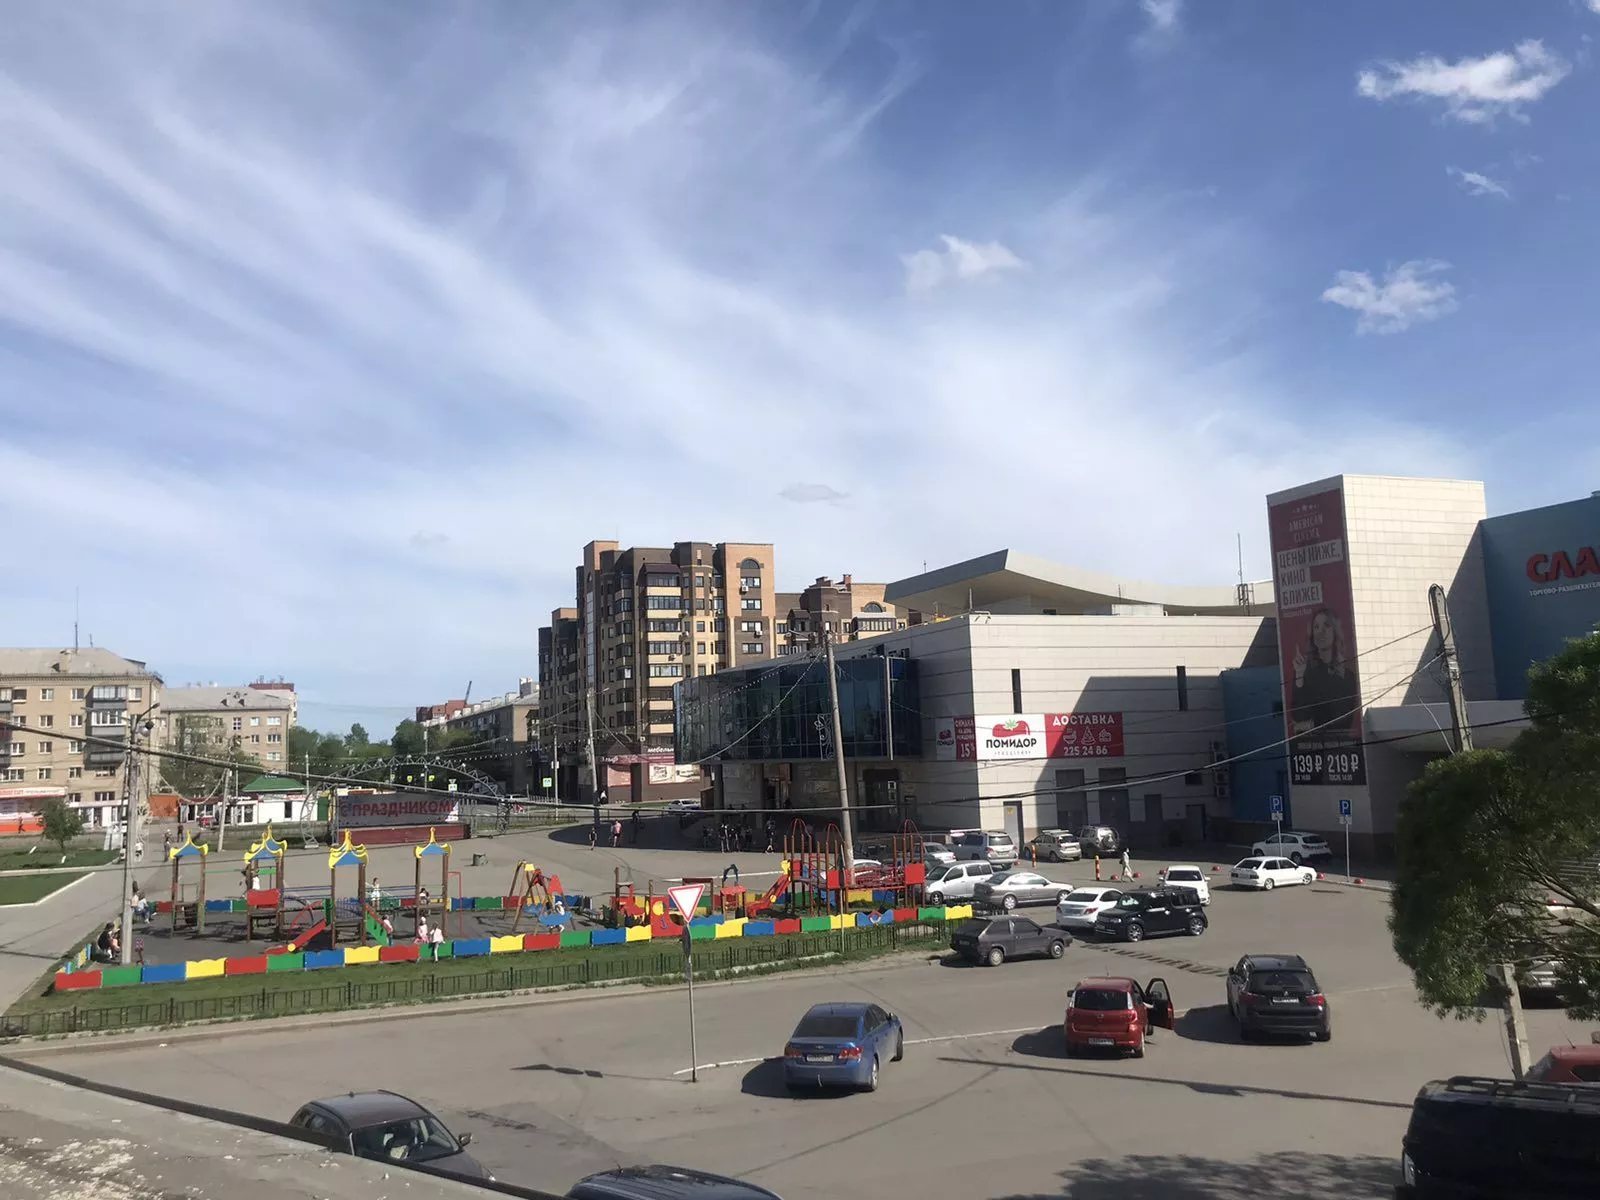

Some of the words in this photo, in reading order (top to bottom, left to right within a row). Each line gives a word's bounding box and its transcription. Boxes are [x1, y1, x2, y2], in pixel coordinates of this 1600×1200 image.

[1279, 551, 1306, 569] ЦЕНЫ
[1280, 568, 1305, 588] КИНО
[1282, 585, 1320, 606] БЛИЖЕ!
[1052, 715, 1115, 727] ДОСТАВКА
[986, 738, 1037, 749] ПОМИДОР
[1063, 746, 1080, 756] 225
[1081, 746, 1094, 756] 24
[1095, 745, 1108, 755] 86
[1293, 755, 1313, 773] 139
[1327, 754, 1348, 773] 219
